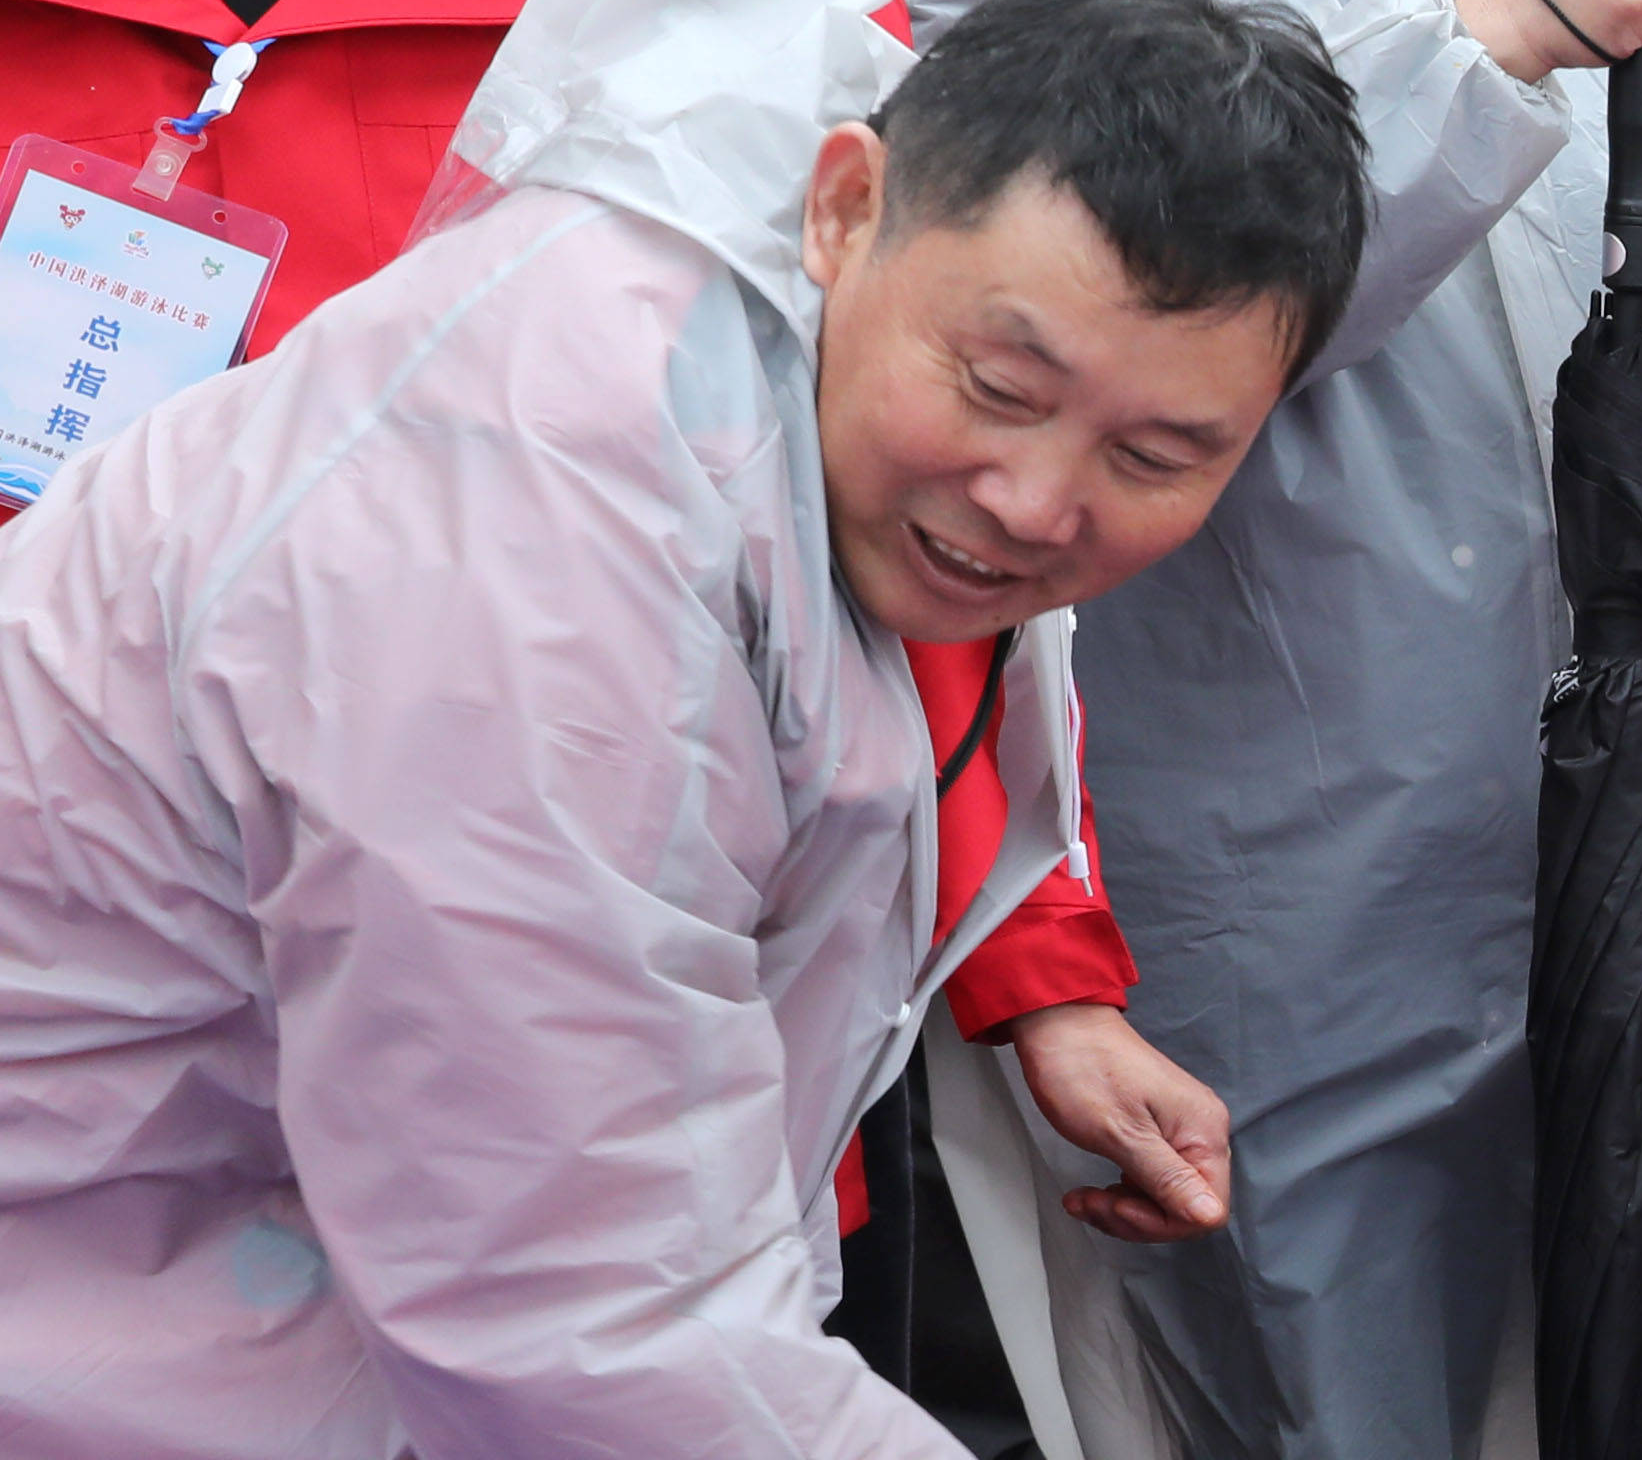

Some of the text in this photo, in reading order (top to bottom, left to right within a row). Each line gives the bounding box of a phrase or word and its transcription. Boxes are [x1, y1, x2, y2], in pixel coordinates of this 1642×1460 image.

[28, 251, 210, 331] 中国洪泽湖游泳比赛
[44, 314, 122, 442] 总指挥
